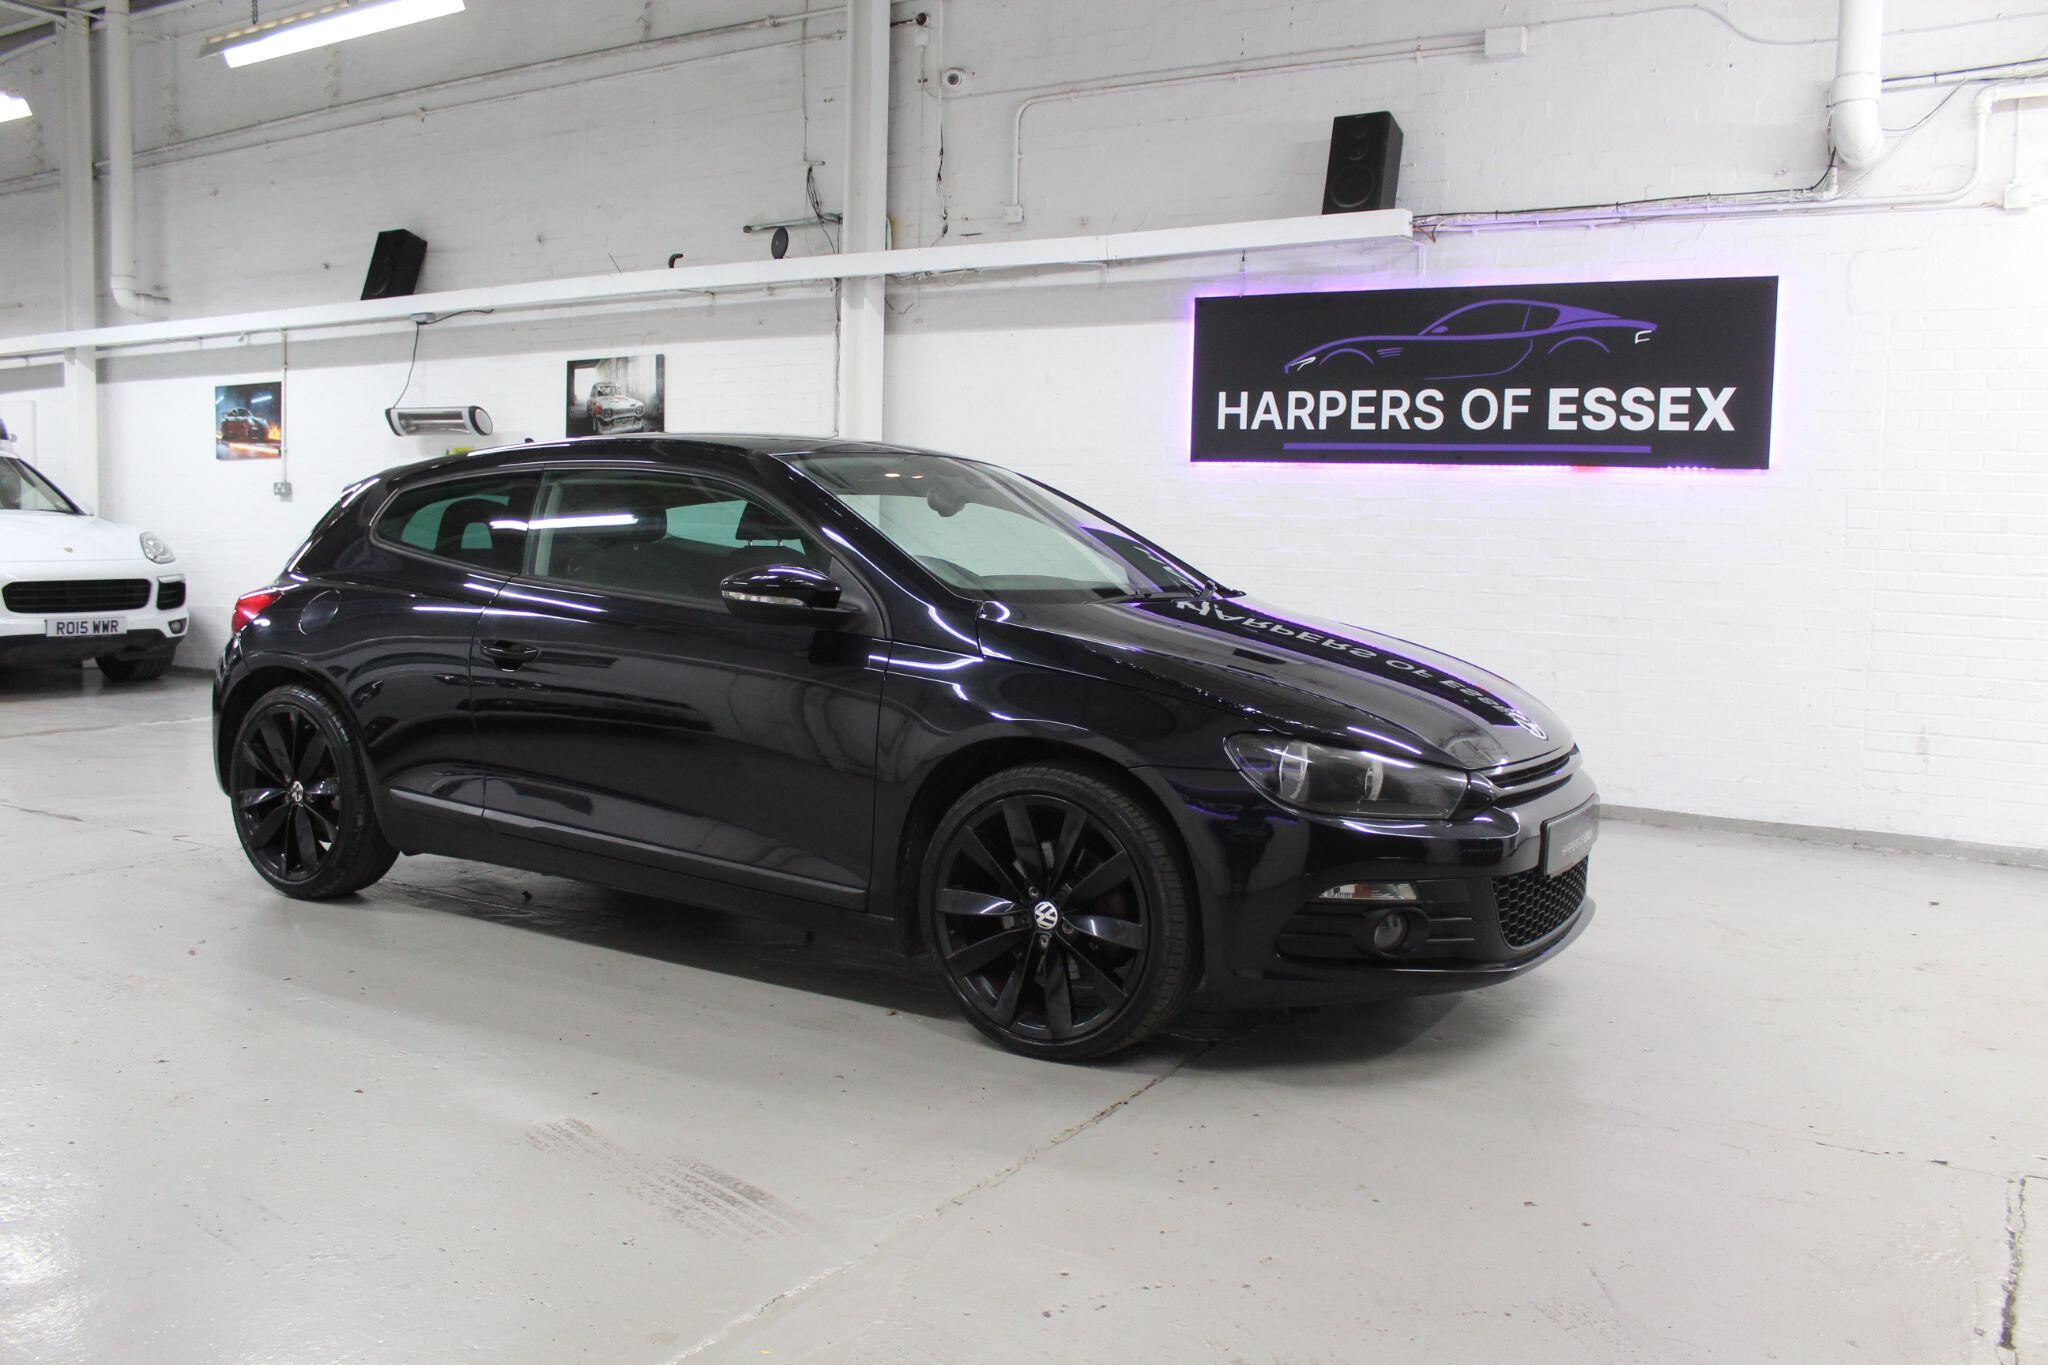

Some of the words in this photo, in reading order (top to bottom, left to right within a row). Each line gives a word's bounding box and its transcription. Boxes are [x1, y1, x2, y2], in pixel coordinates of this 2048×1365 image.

[1217, 388, 1445, 430] HARPERS
[1461, 388, 1532, 430] OF
[1548, 387, 1737, 431] ESSEX
[92, 620, 119, 633] WWR
